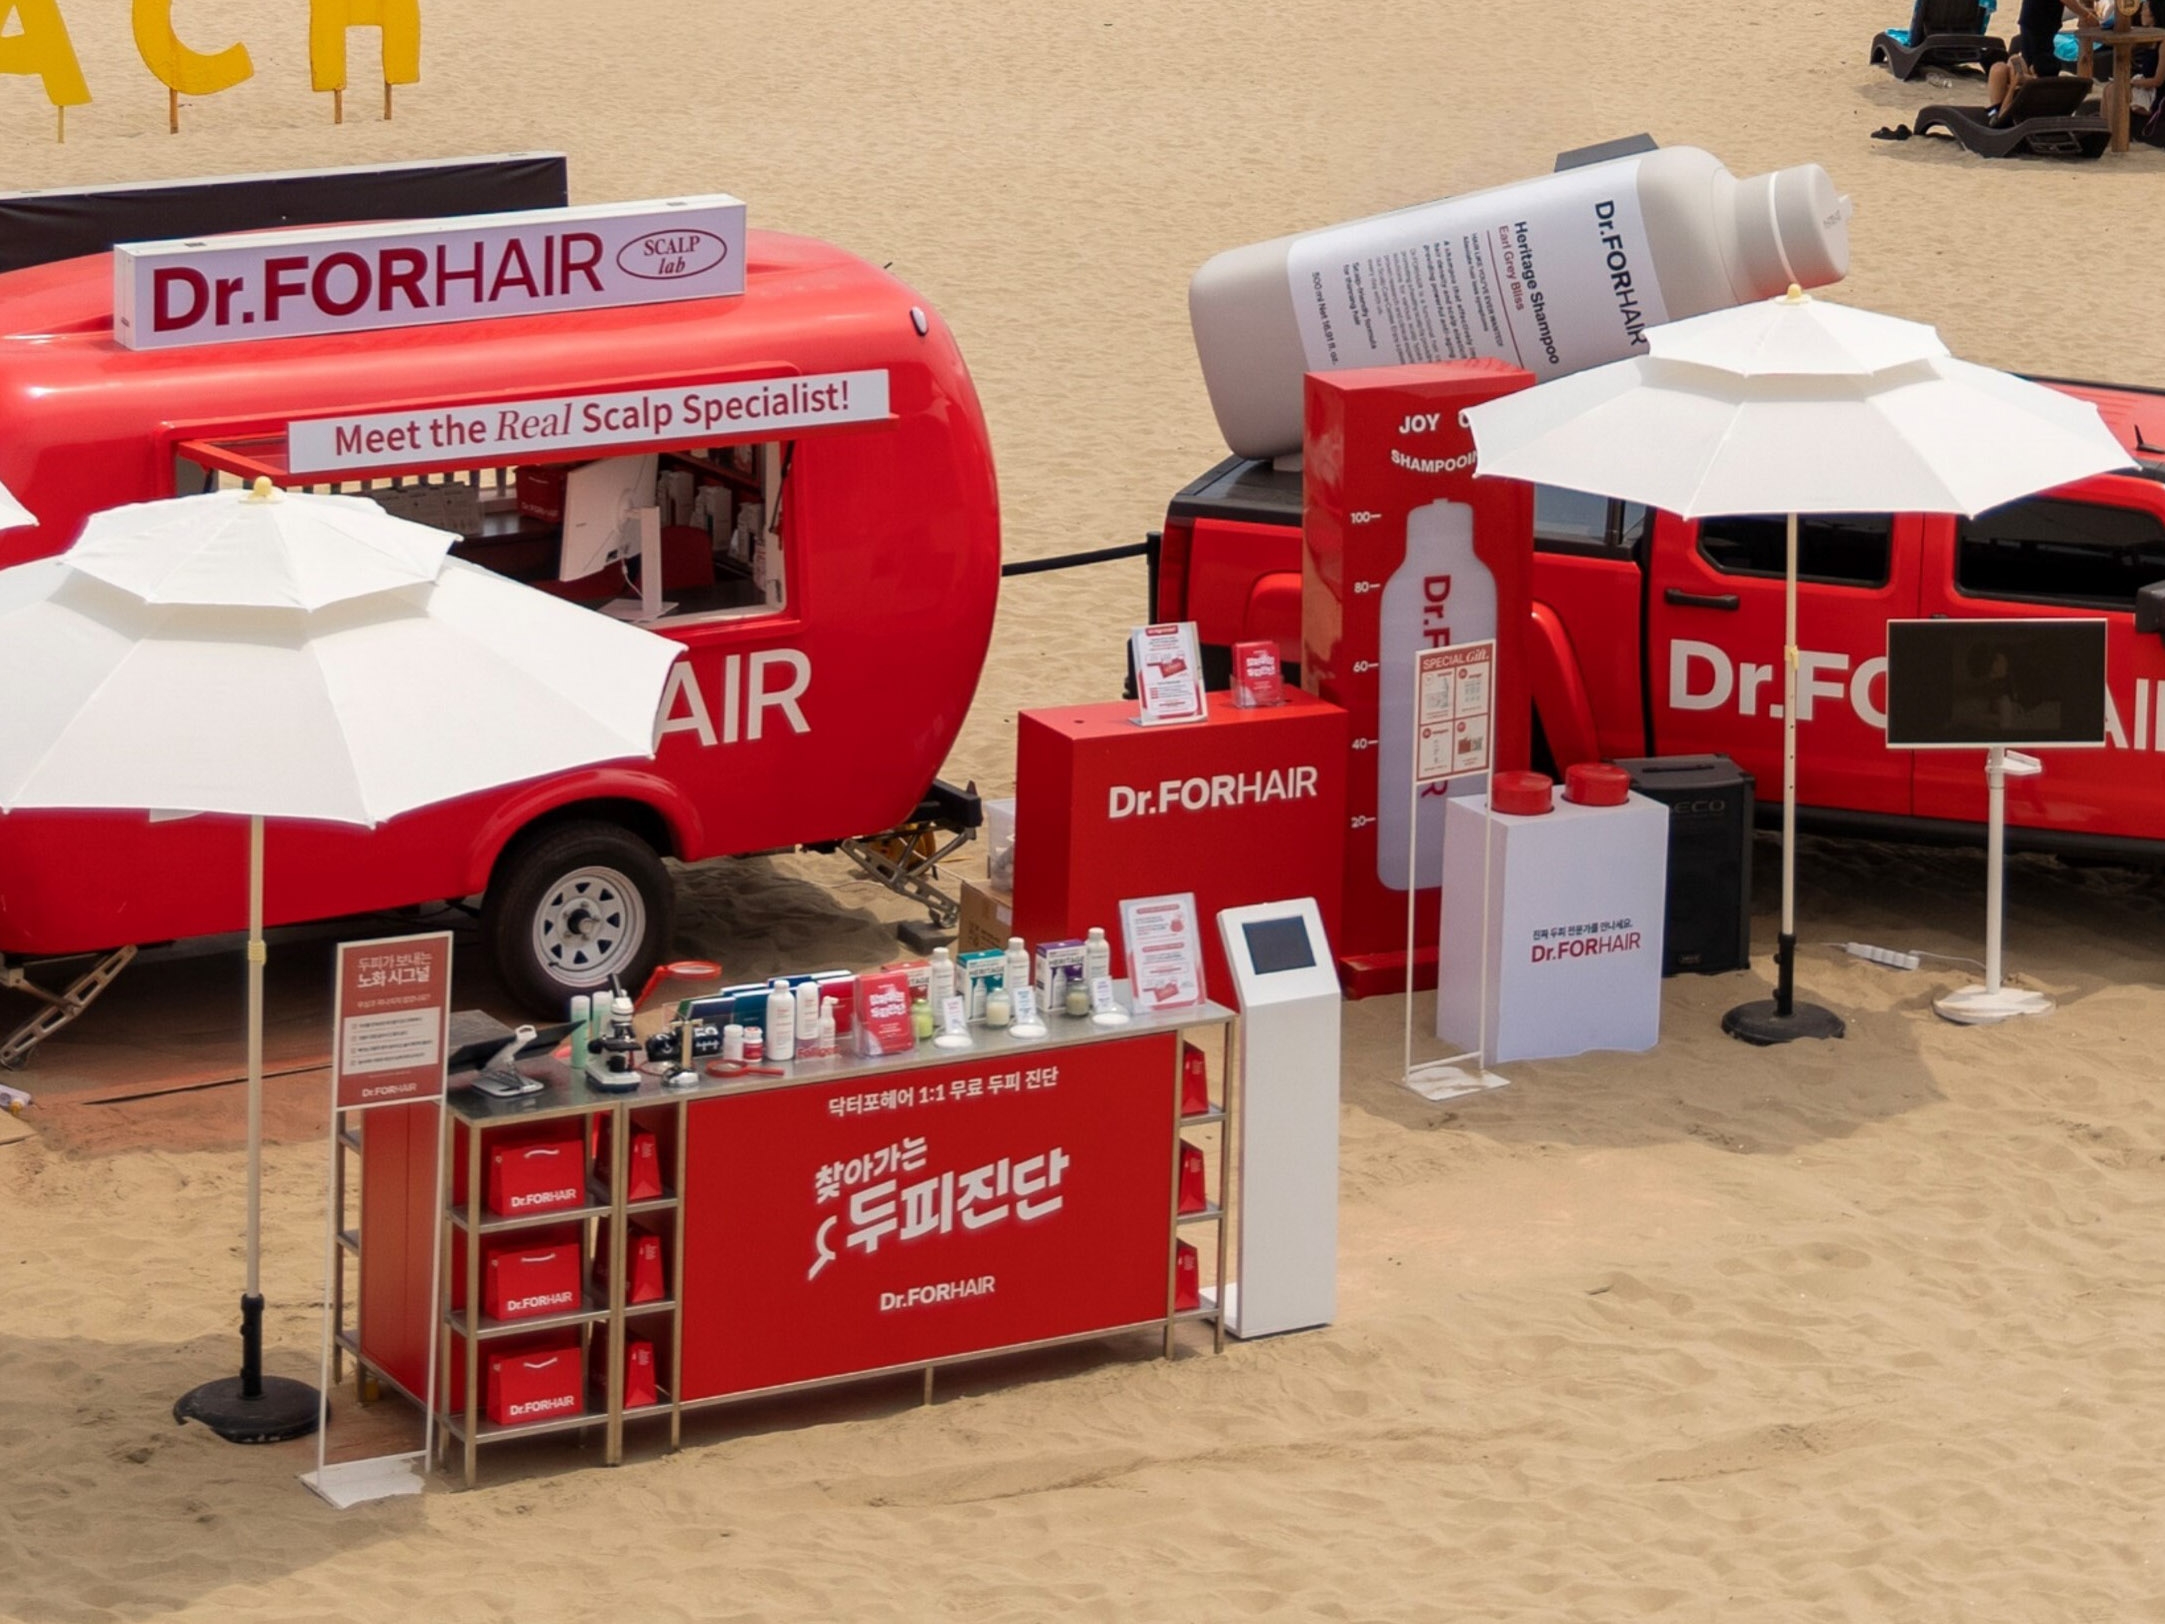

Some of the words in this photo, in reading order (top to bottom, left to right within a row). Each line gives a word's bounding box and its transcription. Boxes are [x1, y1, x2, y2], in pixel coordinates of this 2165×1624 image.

[643, 235, 701, 257] SCALP
[1499, 225, 1512, 249] Earl
[658, 256, 686, 275] lab
[1504, 251, 1517, 279] Grey
[1595, 199, 1648, 347] Dr.FORHAIR
[153, 231, 605, 333] Dr.FORHAIR
[1312, 272, 1322, 290] 500
[1510, 281, 1524, 311] Bliss
[1514, 221, 1537, 290] Heritage
[1530, 292, 1560, 364] Shampoo
[1319, 303, 1328, 319] Net
[1484, 296, 1494, 314] EVER
[1323, 320, 1334, 341] 16.91
[335, 420, 422, 457] Meet
[429, 414, 487, 448] the
[494, 403, 573, 442] Real
[582, 396, 673, 435] Scalp
[682, 379, 850, 431] Specialist!
[1399, 412, 1440, 434] JOY
[1350, 511, 1371, 524] 100
[1354, 581, 1370, 594] 80
[1353, 660, 1369, 673] 60
[1422, 653, 1465, 671] SPECIAL
[1352, 738, 1368, 751] 40
[1108, 766, 1318, 819] Dr.FORHAIR
[1350, 817, 1367, 829] 20
[1531, 931, 1641, 963] Dr.FORHAIR
[357, 955, 395, 972] 두피가
[396, 951, 433, 968] 보내는
[357, 971, 386, 989] 노화
[388, 965, 431, 986] 시그널
[362, 1083, 417, 1098] Dr.FORHAIR
[828, 1086, 914, 1117] 닥터포헤어
[919, 1086, 946, 1105] 1:1
[949, 1078, 984, 1100] 무료
[987, 1071, 1021, 1096] 두피
[1025, 1065, 1059, 1090] 진단
[815, 1136, 928, 1205] 찾아가는
[510, 1187, 577, 1209] Dr.FORHAIR
[846, 1147, 1070, 1254] 두피진단
[507, 1291, 573, 1312] Dr.FORHAIR
[879, 1275, 996, 1312] Dr.FORHAIR
[509, 1395, 575, 1417] Dr.FORHAIR
